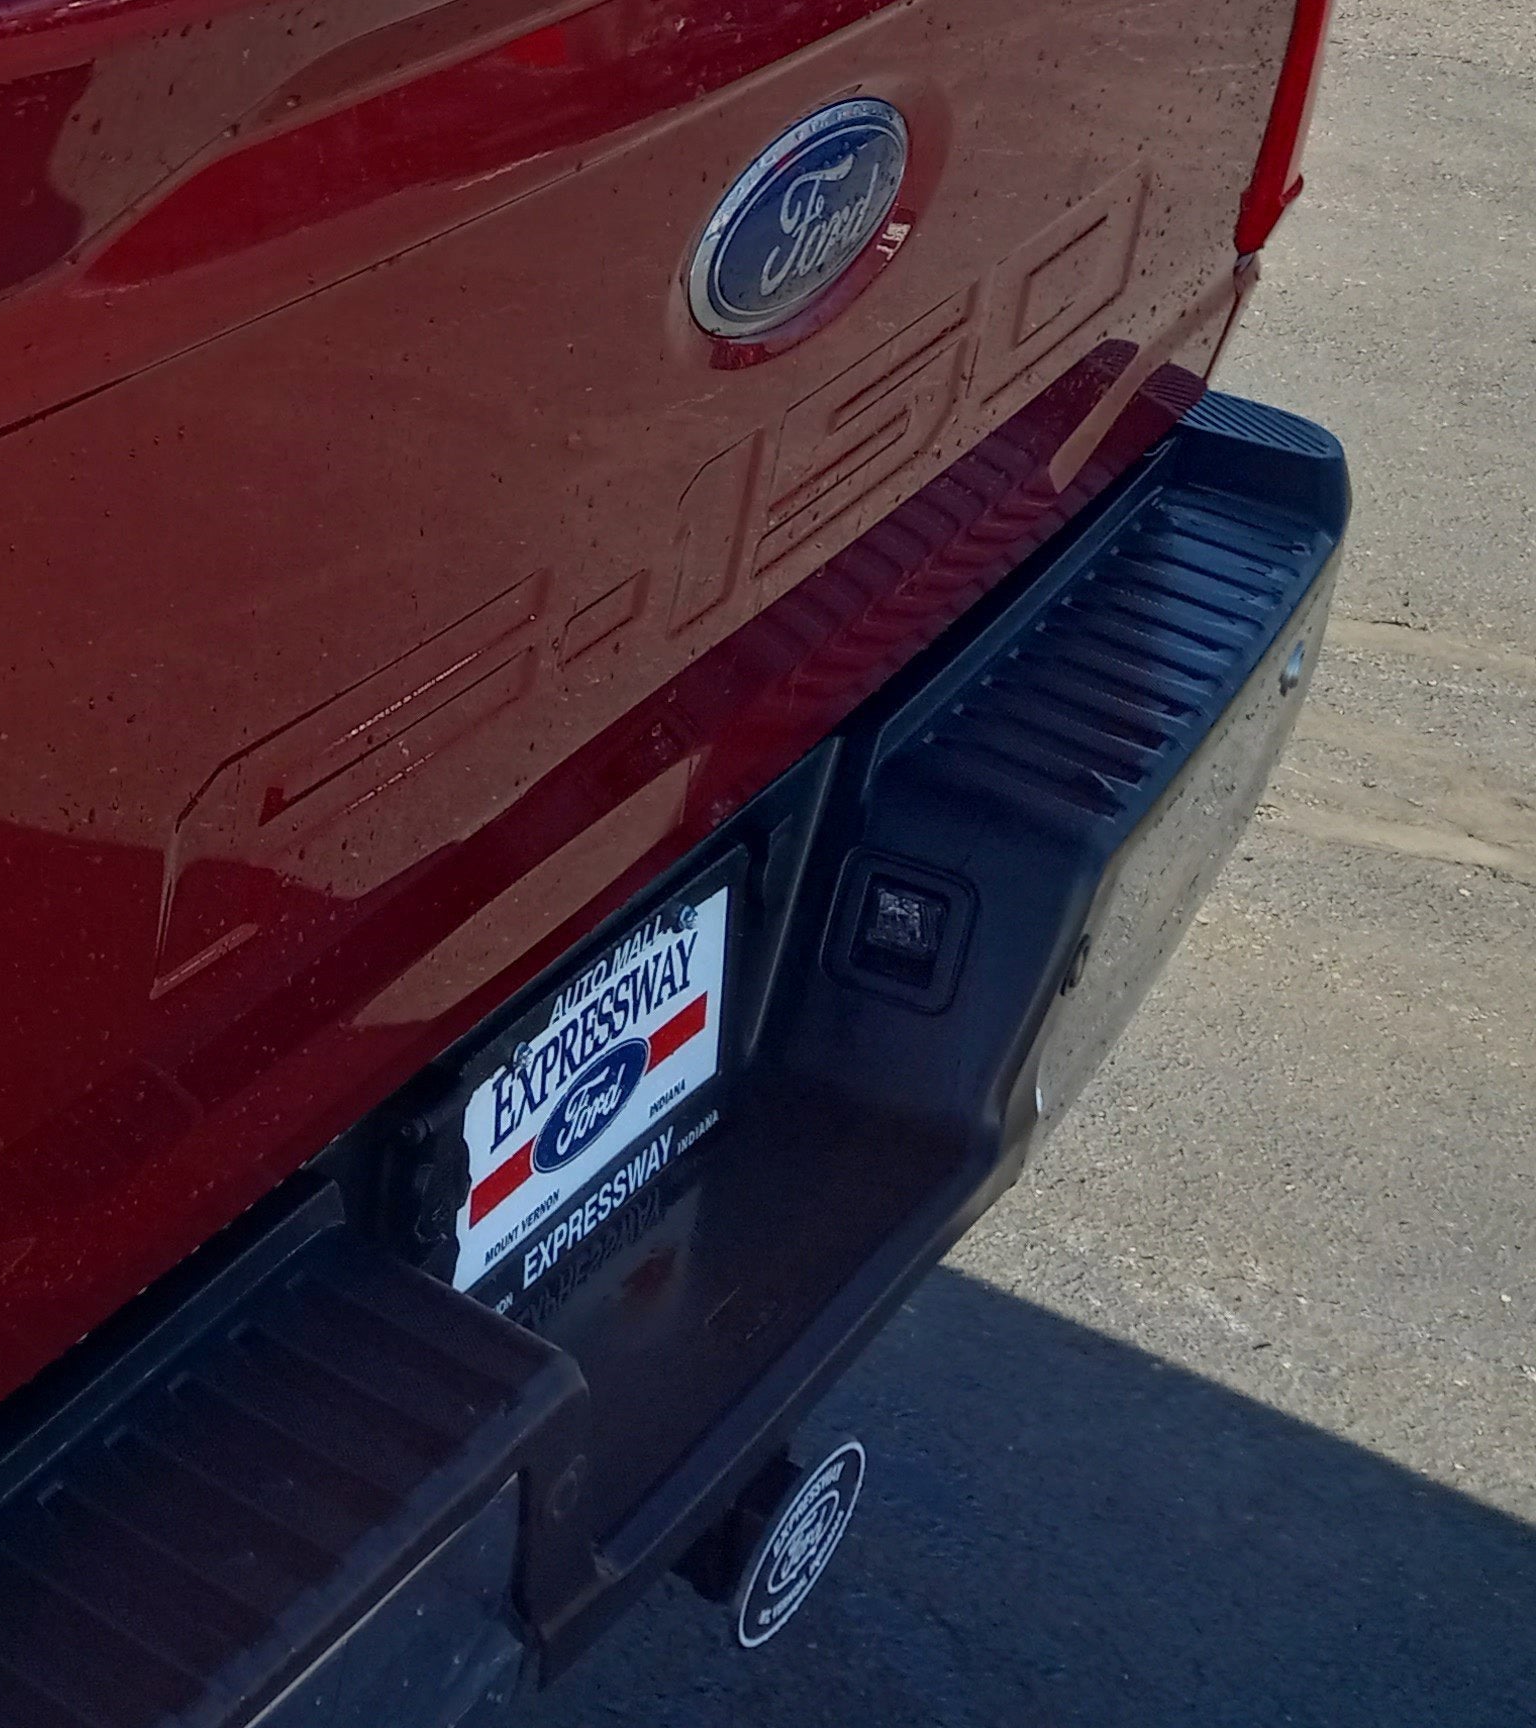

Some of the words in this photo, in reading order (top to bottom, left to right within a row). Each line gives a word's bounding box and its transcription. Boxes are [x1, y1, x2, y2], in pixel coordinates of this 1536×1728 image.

[760, 154, 879, 297] Ford
[551, 958, 608, 1022] AUTO
[612, 916, 668, 975] MALL
[490, 931, 699, 1155] EXPRESSWAY
[556, 1062, 623, 1156] Ford
[649, 1079, 686, 1118] INDIANA
[677, 1109, 720, 1155] INDIANA
[484, 1227, 520, 1266] MOUNT
[520, 1188, 560, 1239] VERNON
[523, 1126, 675, 1290] EXPRESSWAY
